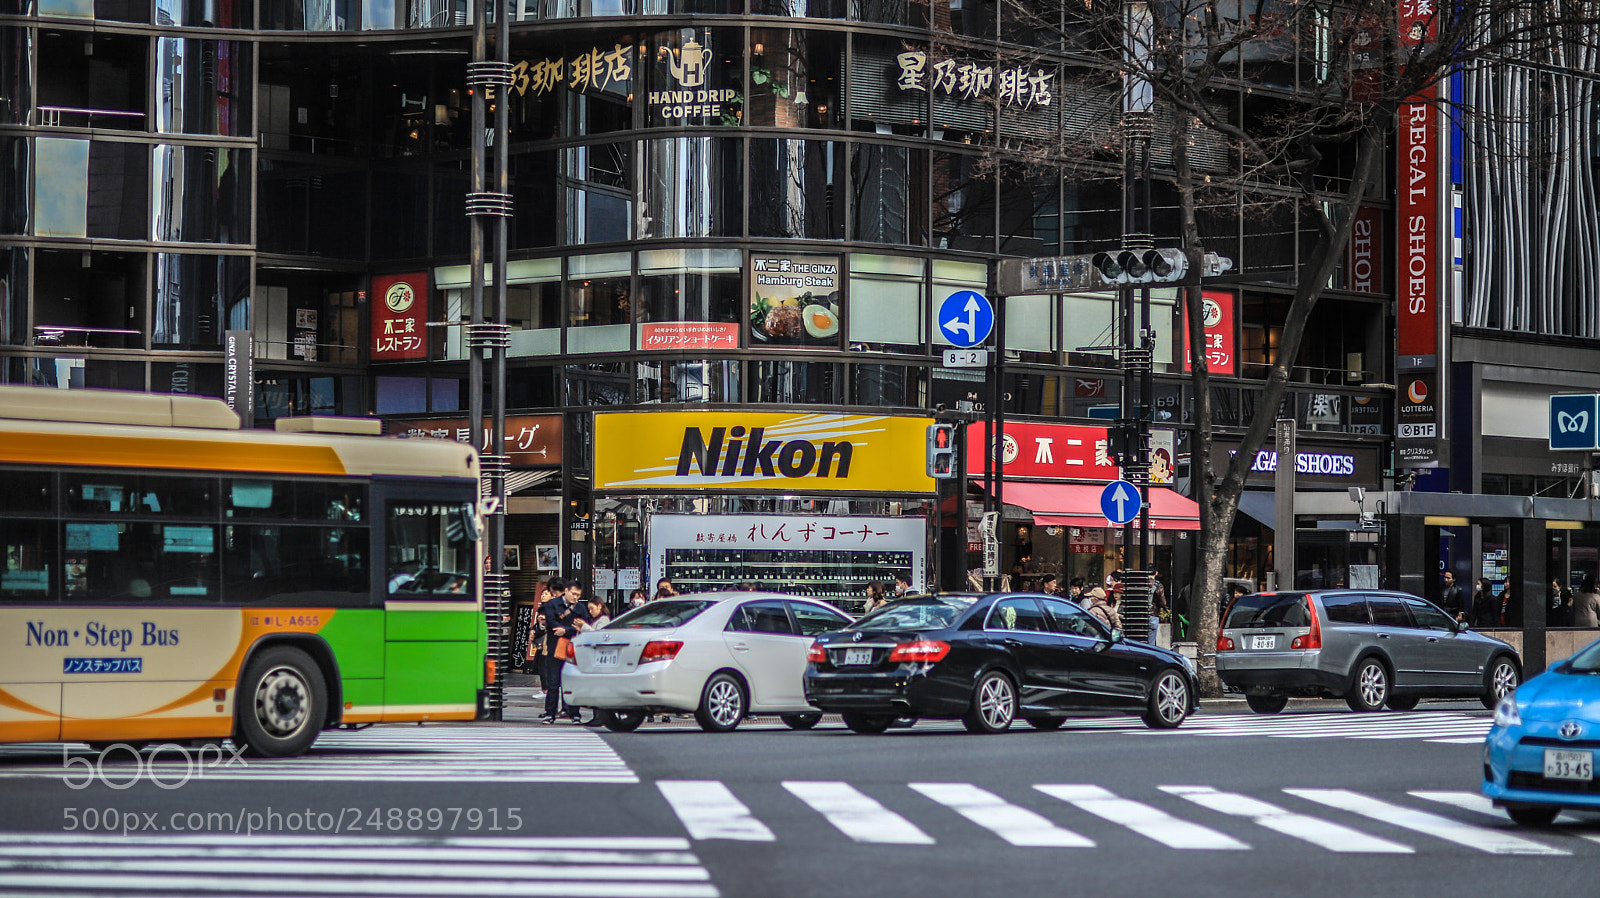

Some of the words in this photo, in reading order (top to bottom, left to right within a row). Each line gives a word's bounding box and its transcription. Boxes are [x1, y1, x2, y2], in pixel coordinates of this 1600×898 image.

[896, 50, 1055, 111] 星乃珈琲店
[649, 90, 694, 105] HAND
[697, 88, 737, 103] DRIP
[660, 104, 721, 119] COFFEE
[1409, 103, 1427, 205] REGAL
[754, 258, 791, 273] 不二家
[793, 264, 810, 274] THE
[811, 263, 838, 275] GINZA
[1408, 215, 1426, 315] SHOES
[757, 274, 803, 288] Hamburg
[805, 275, 834, 288] Steak
[383, 317, 416, 335] 不二家
[228, 336, 236, 357] GINZA
[376, 336, 422, 353] レストラン
[646, 334, 735, 345] イタリアンショートケーキ
[1413, 357, 1423, 367] 1F
[227, 358, 237, 394] CRYSTAL
[1401, 405, 1434, 413] LOTTERIA
[1413, 425, 1434, 436] B1F
[675, 425, 854, 479] Nikon
[1297, 453, 1354, 475] SHOES
[747, 523, 890, 543] れんずコーナー
[141, 622, 179, 647] Bus
[63, 658, 142, 673] ノンステップバス
[1555, 761, 1590, 778] 33-45
